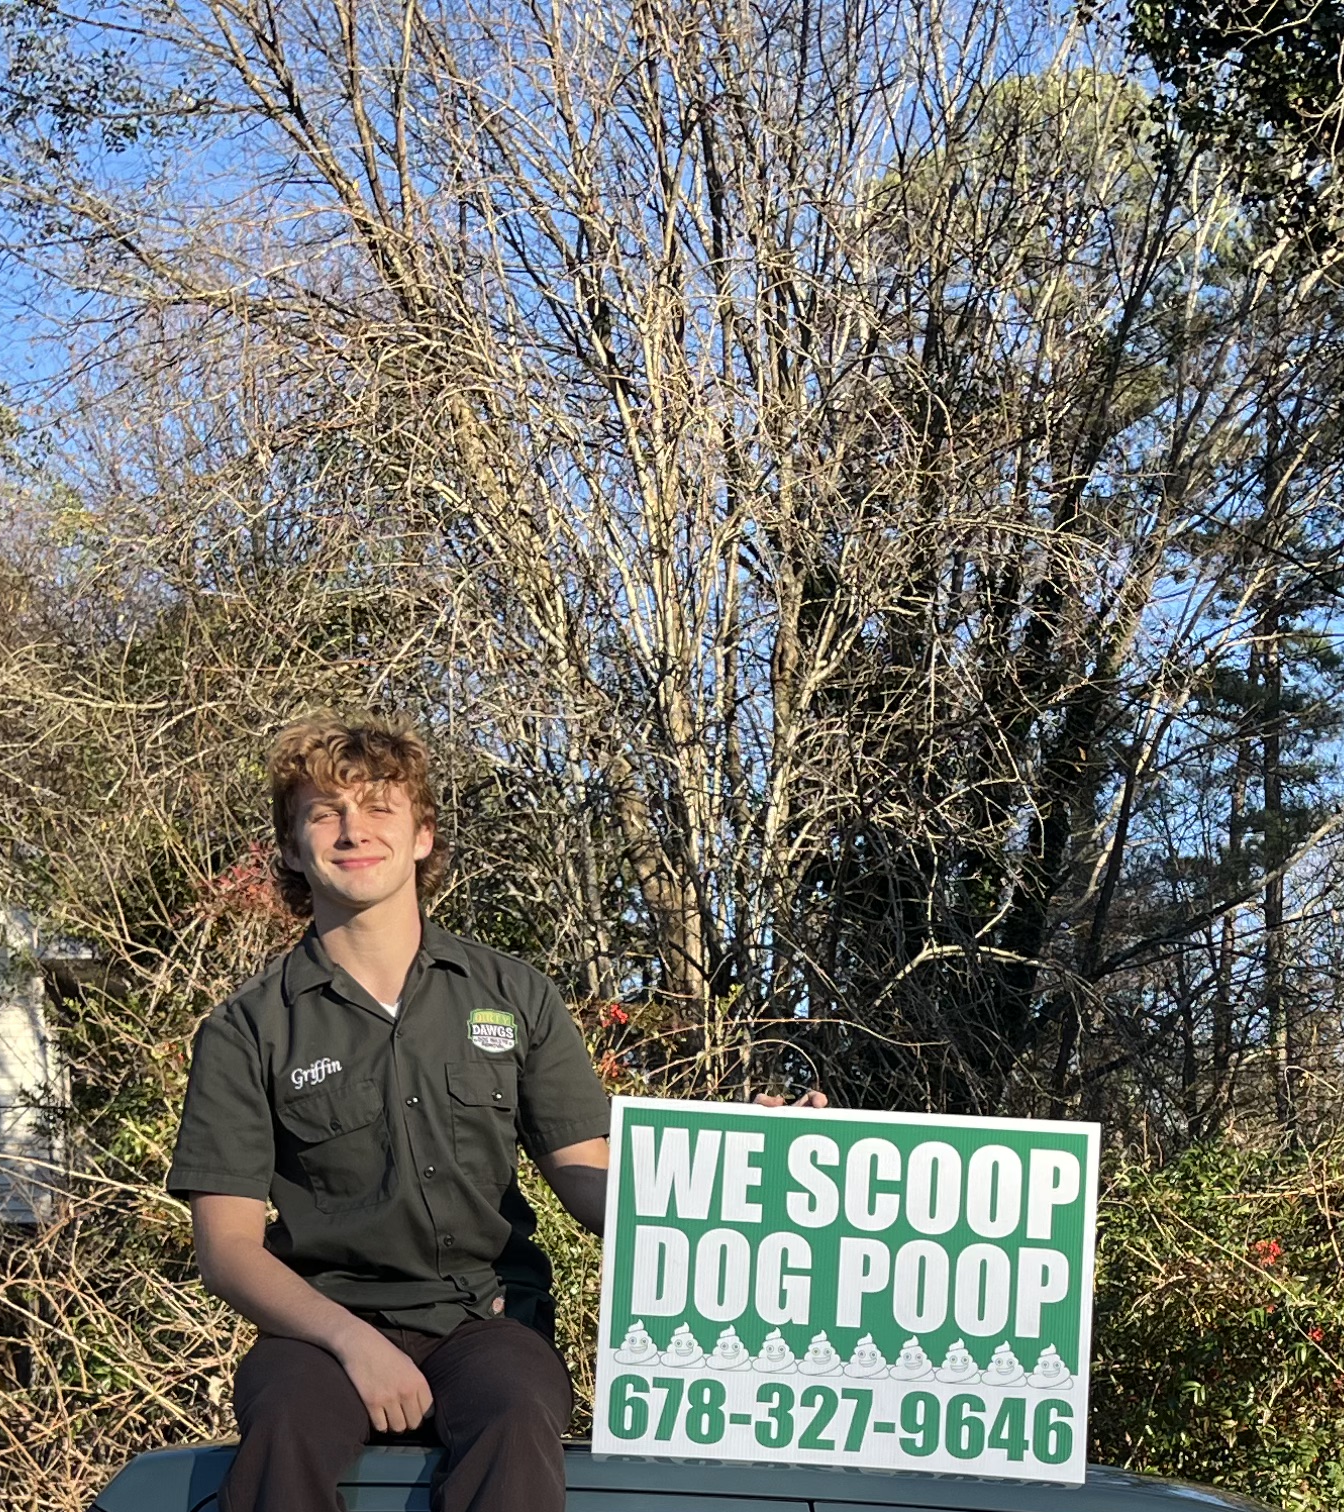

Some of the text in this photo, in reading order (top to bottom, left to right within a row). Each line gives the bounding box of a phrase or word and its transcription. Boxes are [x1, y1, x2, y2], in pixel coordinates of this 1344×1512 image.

[472, 1024, 514, 1039] DAWGS
[475, 1012, 510, 1026] DIRTY
[291, 1057, 343, 1090] Griffin
[630, 1124, 1082, 1241] WE SCOOP
[630, 1224, 1071, 1340] DOG POOP
[607, 1373, 1075, 1466] 678-327-9646
